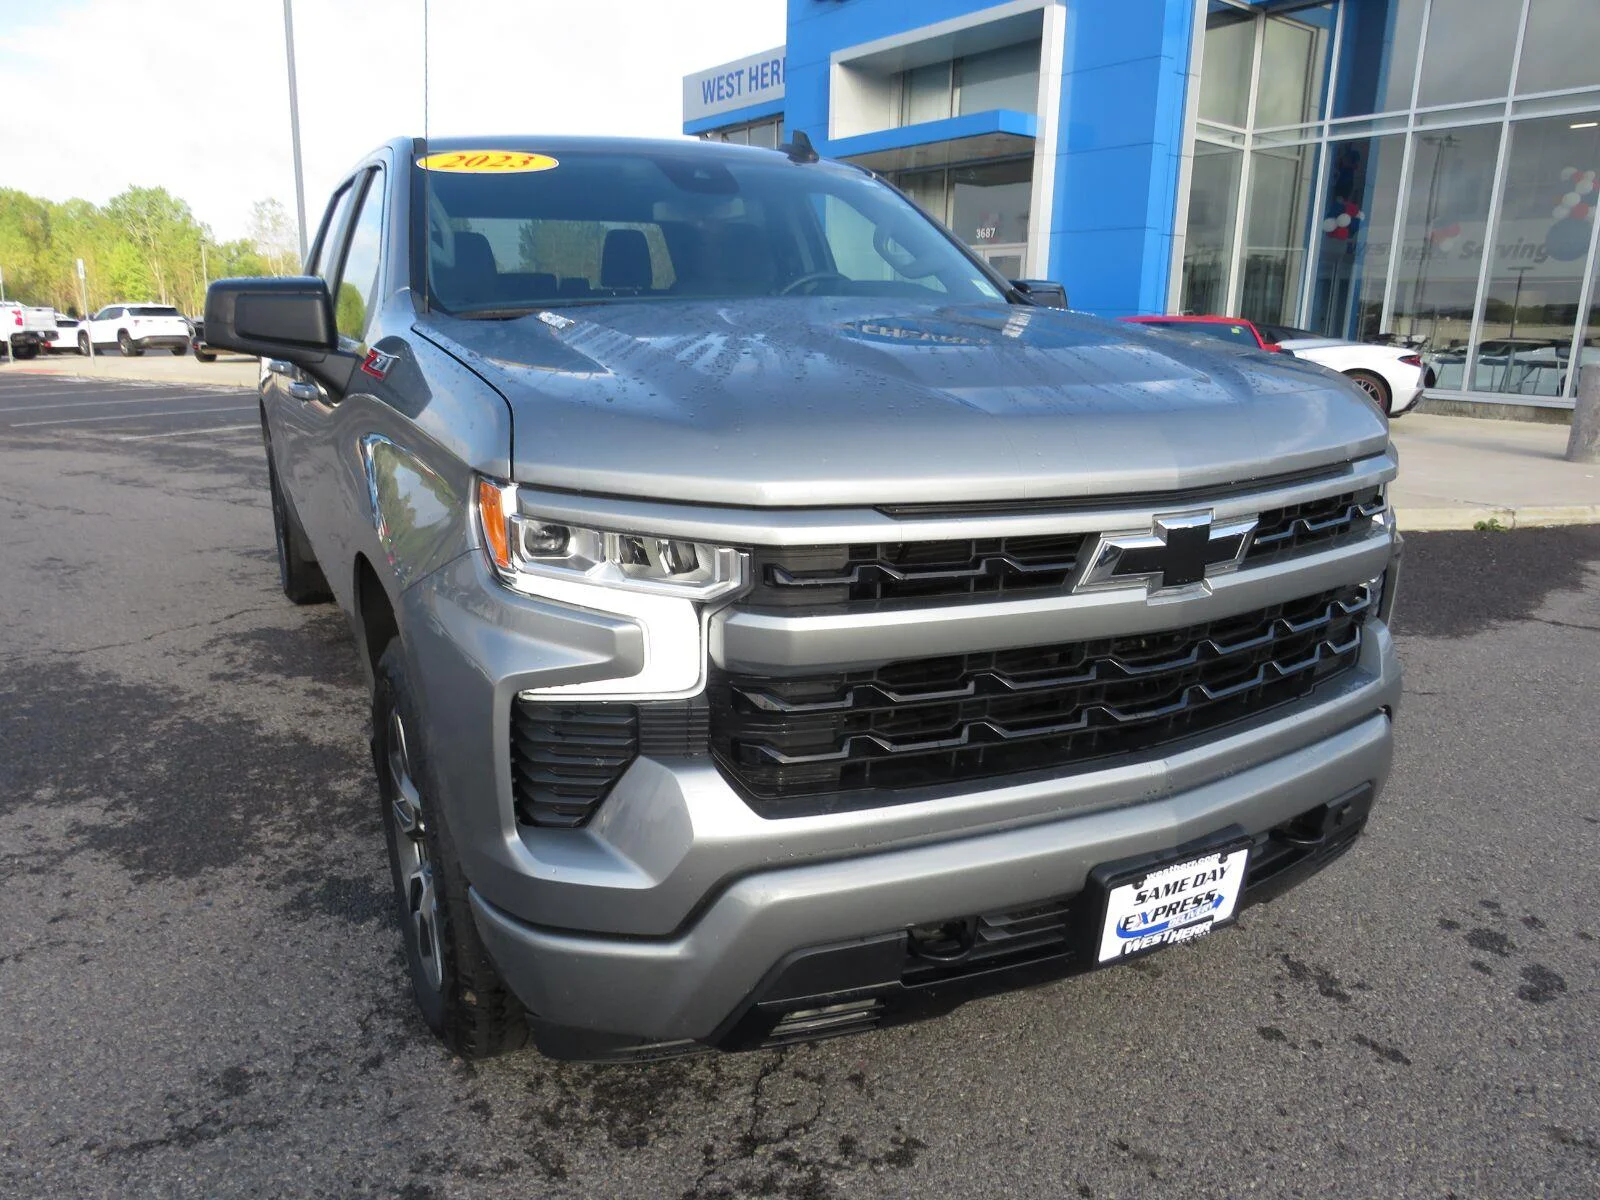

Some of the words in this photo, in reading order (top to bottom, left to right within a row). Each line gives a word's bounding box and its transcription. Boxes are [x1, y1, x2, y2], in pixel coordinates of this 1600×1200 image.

[702, 69, 745, 105] WEST
[748, 57, 786, 93] HER
[440, 154, 536, 168] 2023
[976, 227, 996, 239] 3687
[1134, 877, 1191, 906] SAME
[1192, 864, 1232, 888] DAY
[1121, 889, 1217, 931] EXPRESS
